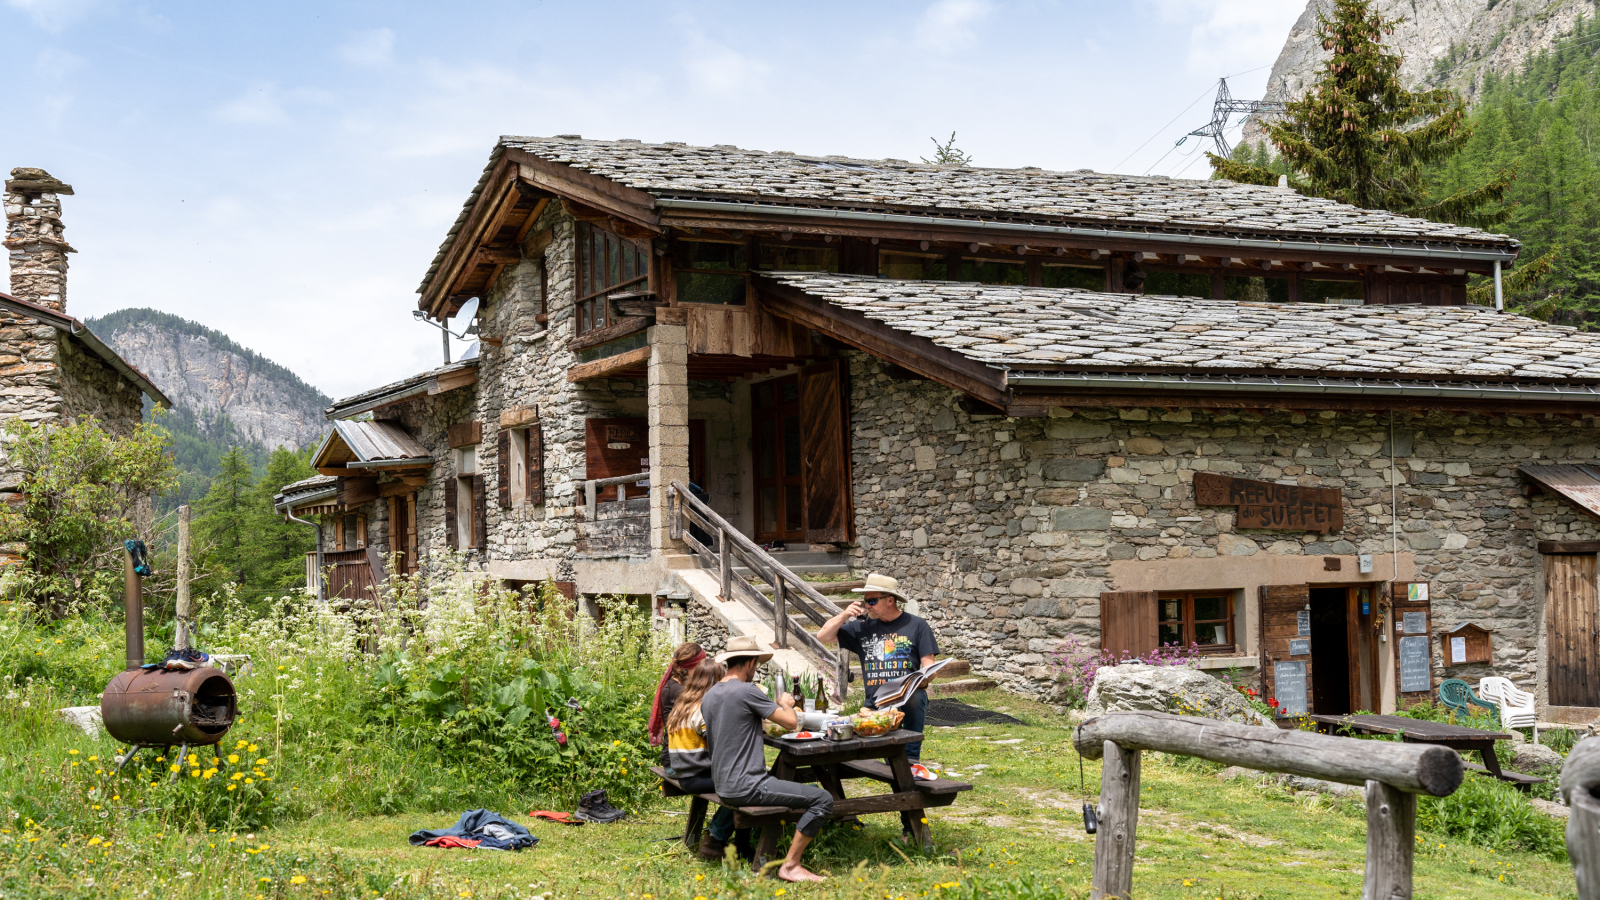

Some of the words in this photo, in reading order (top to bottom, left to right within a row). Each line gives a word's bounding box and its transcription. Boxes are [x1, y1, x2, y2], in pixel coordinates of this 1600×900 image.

[1230, 480, 1299, 503] REFUGE
[1242, 508, 1255, 518] du
[1260, 501, 1337, 526] SUFFET
